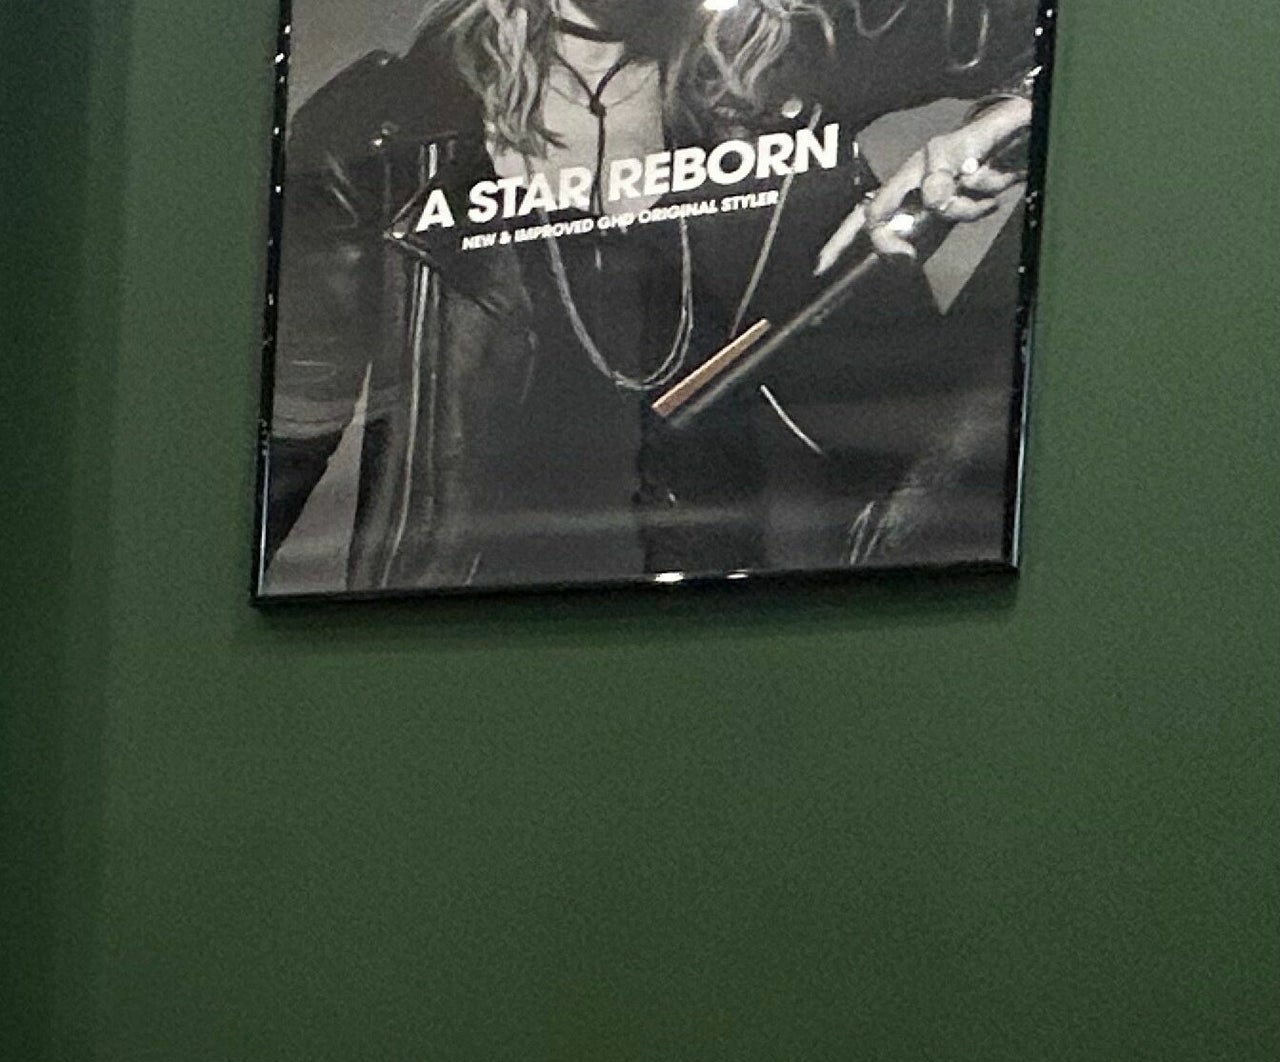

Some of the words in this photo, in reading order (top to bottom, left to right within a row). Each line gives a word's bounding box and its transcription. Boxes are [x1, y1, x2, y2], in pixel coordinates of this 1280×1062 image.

[415, 190, 456, 233] A
[467, 165, 593, 224] STAR
[607, 123, 840, 201] REBORN
[461, 233, 497, 250] NEW
[498, 230, 512, 245] &
[514, 217, 594, 242] IMPROVED
[596, 212, 635, 231] GHD
[638, 199, 719, 224] ORIGINAL
[720, 190, 780, 213] STYLER
